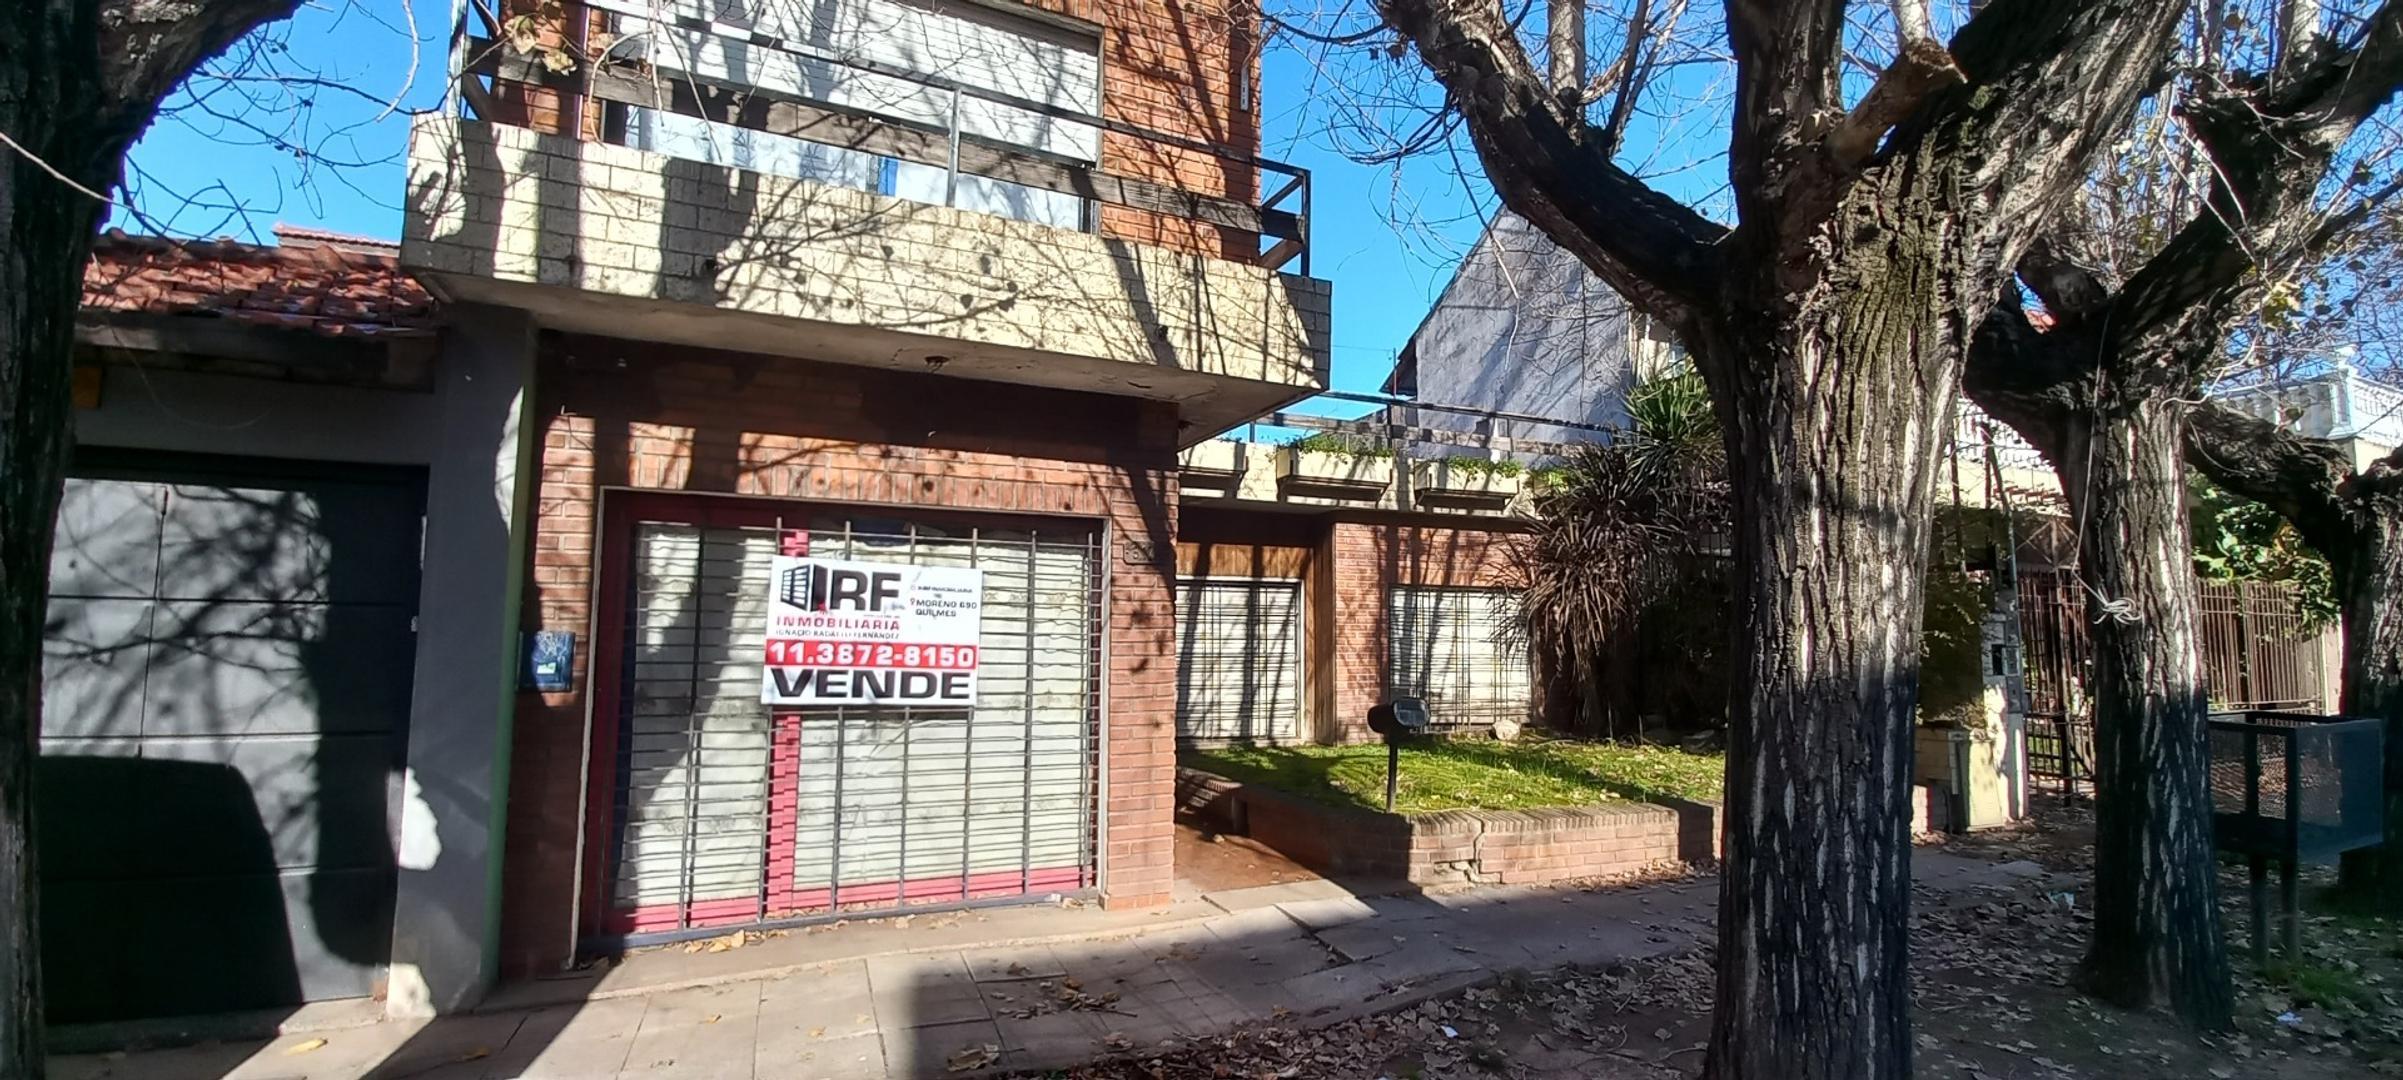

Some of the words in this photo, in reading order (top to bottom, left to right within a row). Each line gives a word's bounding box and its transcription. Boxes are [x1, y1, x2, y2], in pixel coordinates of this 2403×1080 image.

[916, 599, 957, 608] MORENO
[916, 608, 957, 617] QUILMES
[776, 616, 900, 630] INMOBILIARIA
[769, 641, 974, 667] 11.3872-8150
[771, 667, 971, 699] VENDE
